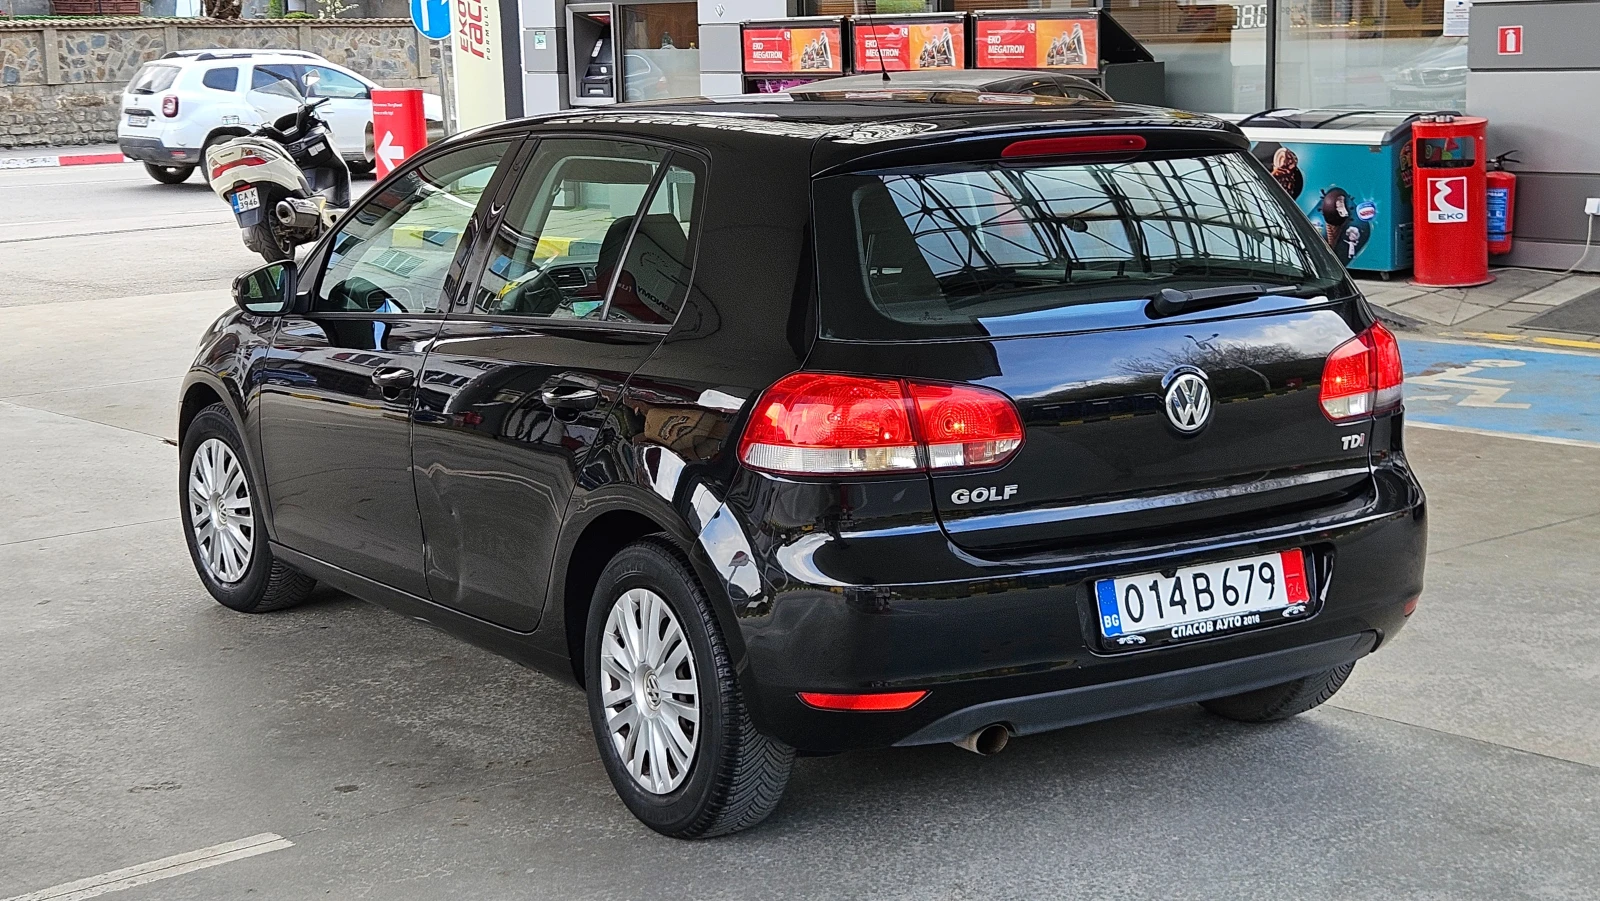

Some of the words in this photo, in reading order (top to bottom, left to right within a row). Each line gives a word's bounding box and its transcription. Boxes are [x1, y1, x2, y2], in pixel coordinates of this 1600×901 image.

[467, 0, 485, 58] rac
[865, 40, 877, 48] EKO
[987, 35, 1001, 44] EKO
[752, 42, 764, 50] EKO
[988, 45, 1024, 53] MEGATRON
[752, 51, 783, 59] MEGATRON
[865, 48, 899, 57] MEGATRON
[239, 198, 258, 209] 3946
[951, 484, 1018, 505] GOLF
[1104, 614, 1120, 629] BG
[1171, 622, 1214, 639] СПАСОВ
[1215, 615, 1242, 631] АУТО
[1243, 614, 1260, 625] 2016
